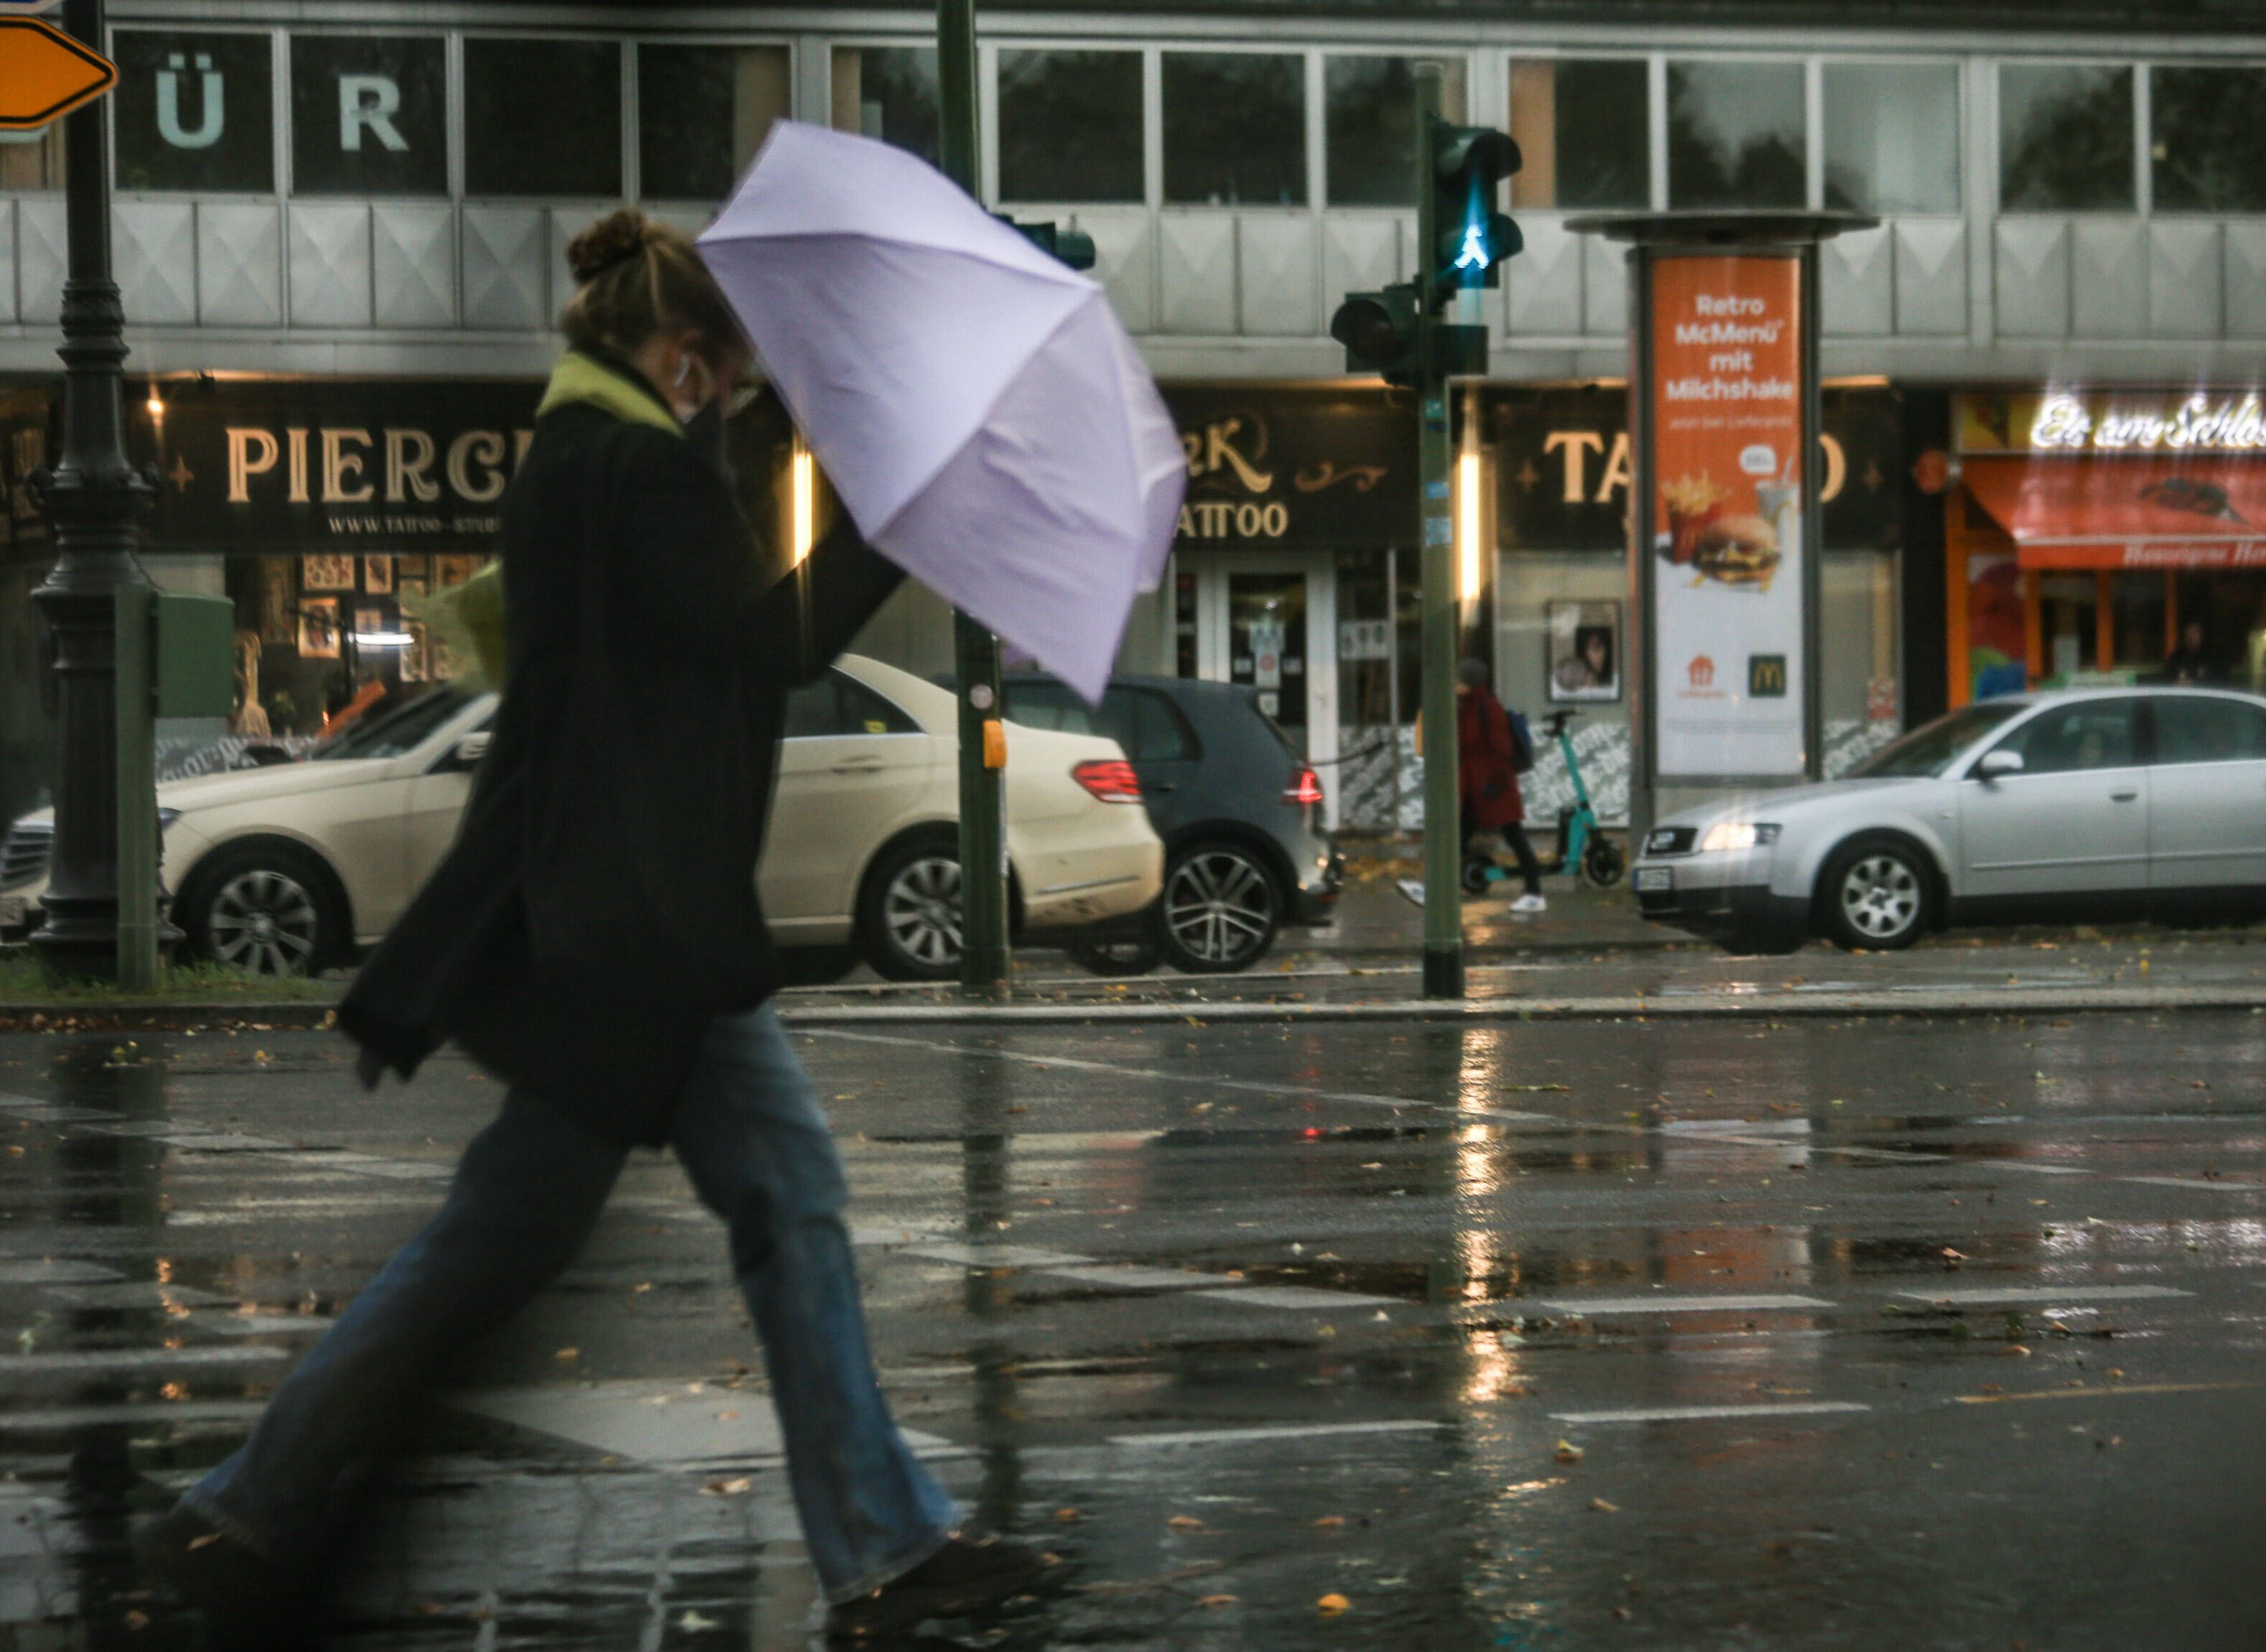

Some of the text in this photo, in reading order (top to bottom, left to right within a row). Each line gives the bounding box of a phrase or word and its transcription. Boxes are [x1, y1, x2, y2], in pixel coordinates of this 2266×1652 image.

[1696, 295, 1765, 316] Retro
[1709, 349, 1755, 372] mit
[1665, 376, 1794, 402] Milchshake
[1172, 501, 1288, 537] ATTOO
